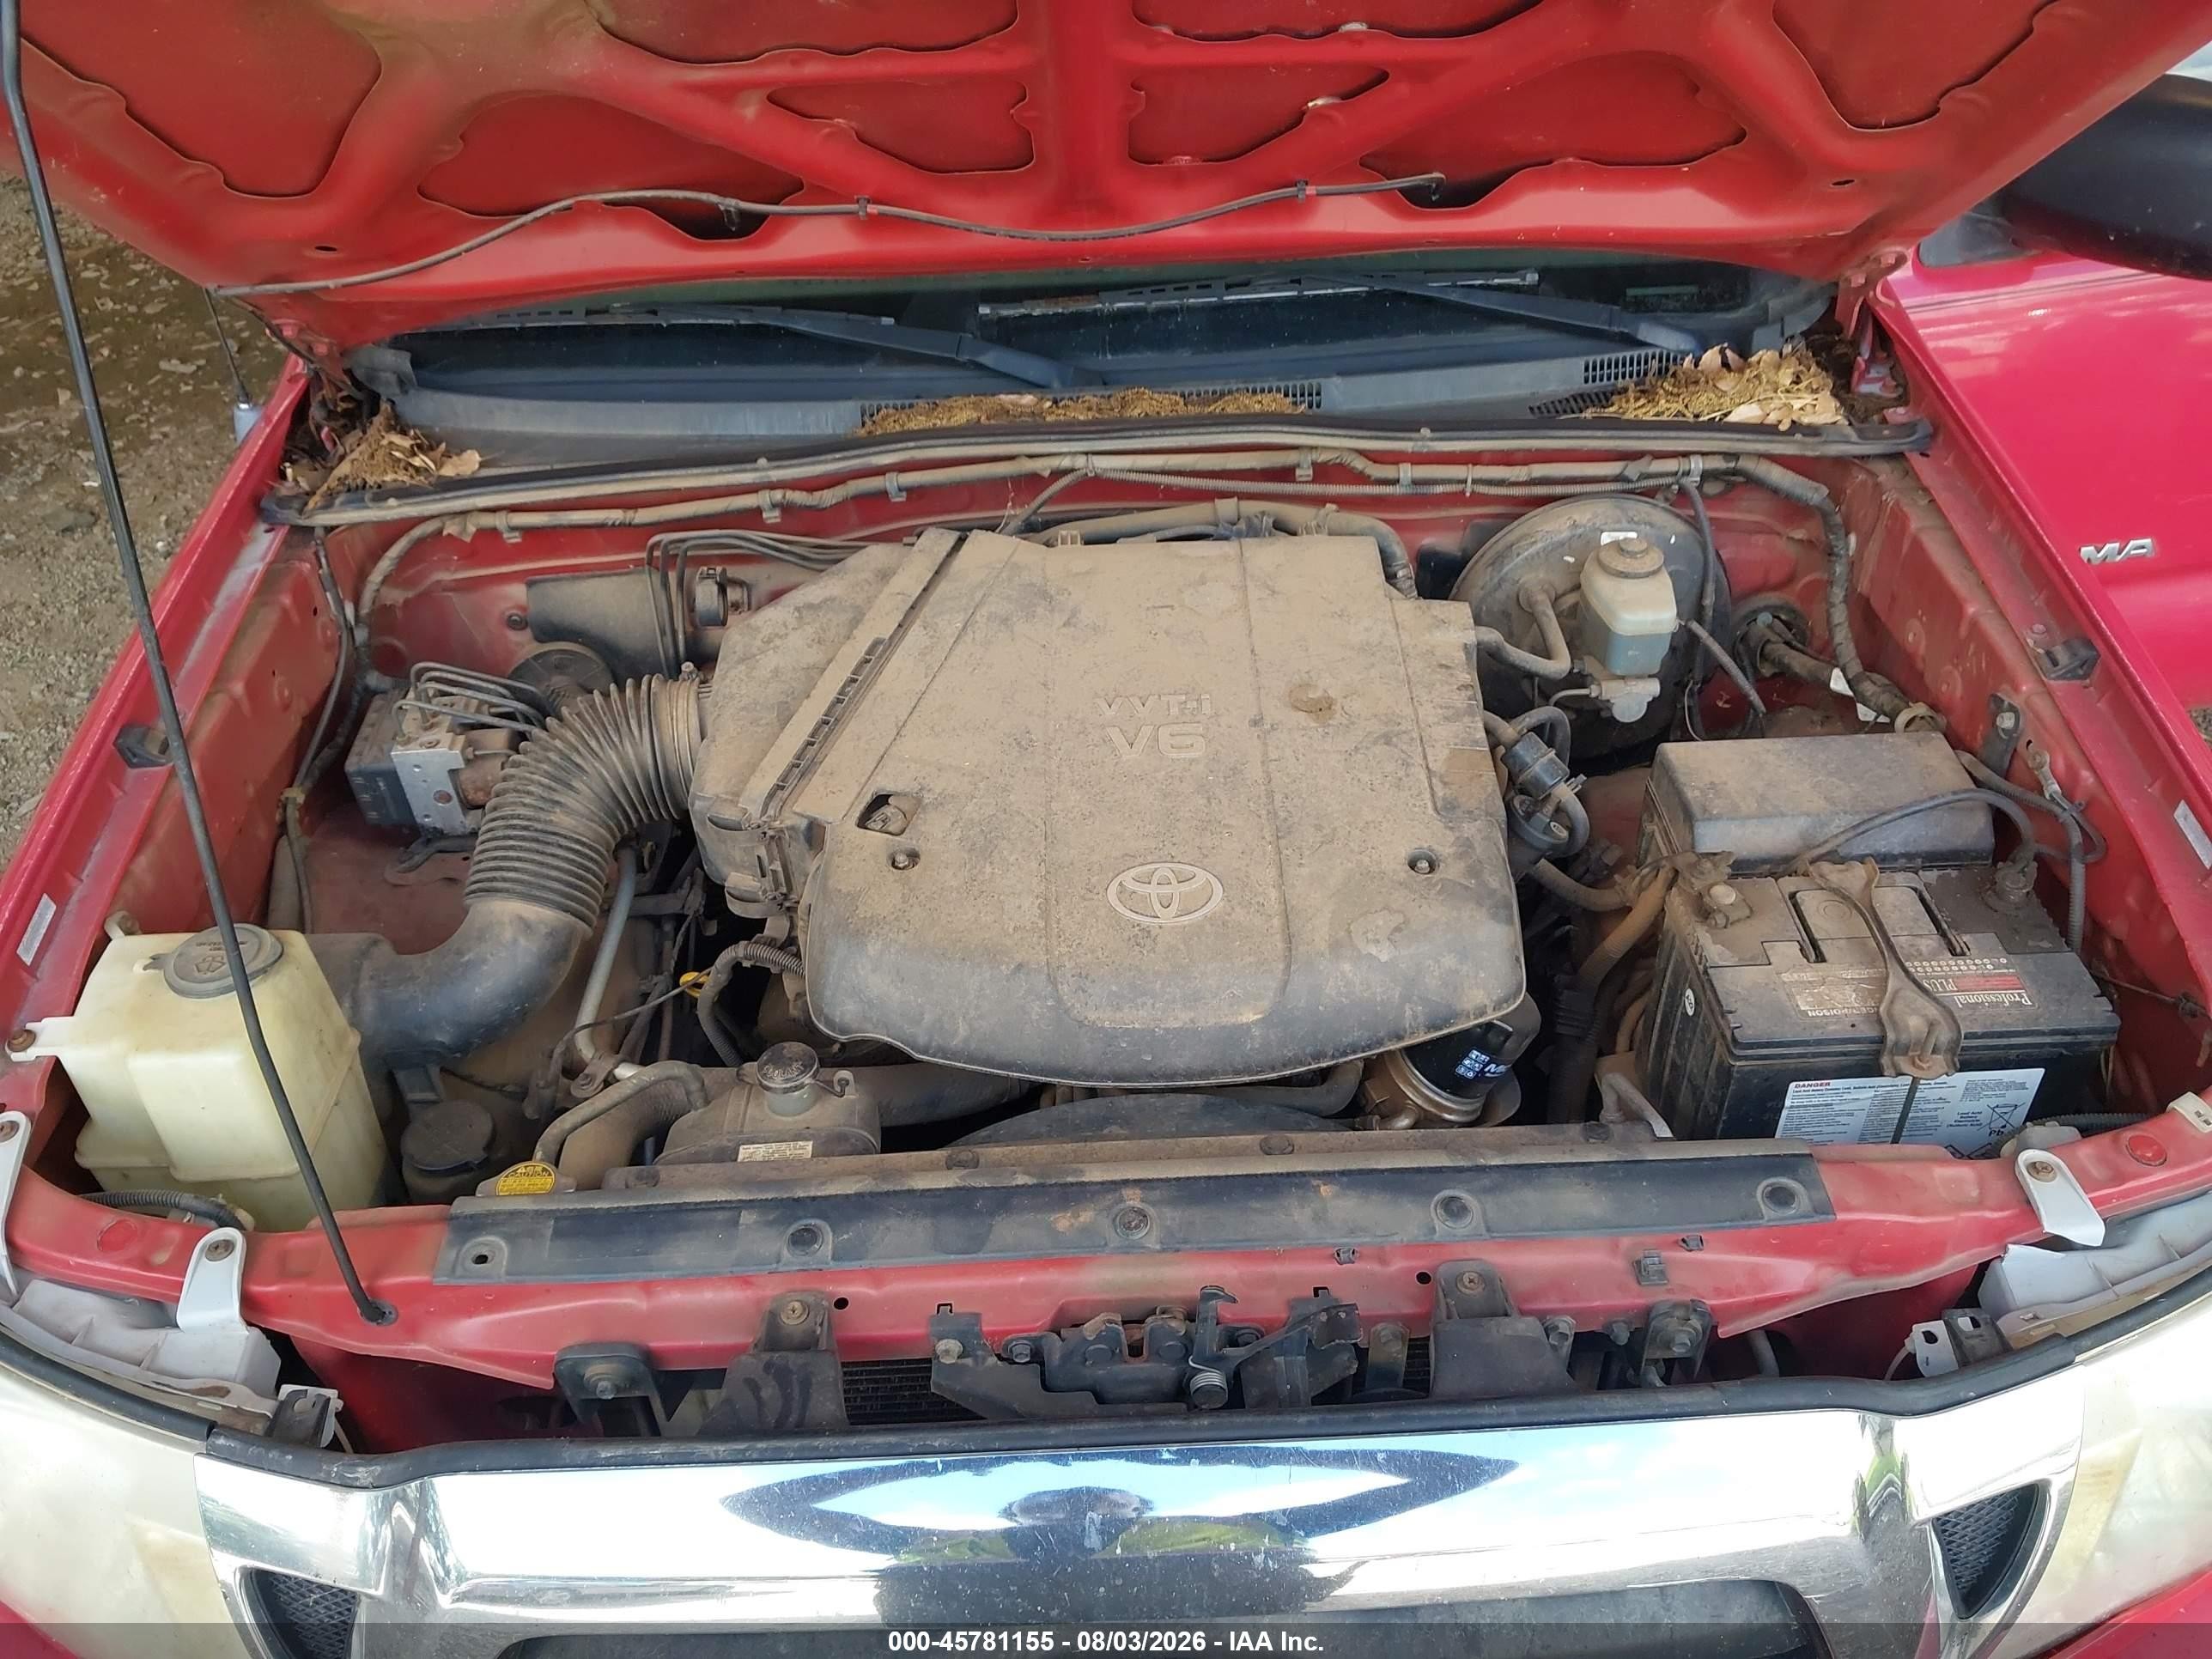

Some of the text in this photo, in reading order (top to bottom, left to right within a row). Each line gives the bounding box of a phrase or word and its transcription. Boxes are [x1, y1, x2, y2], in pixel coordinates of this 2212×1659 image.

[1106, 722, 1206, 757] V6
[1923, 978, 1958, 991] PLUS
[1954, 993, 2033, 1007] Professional
